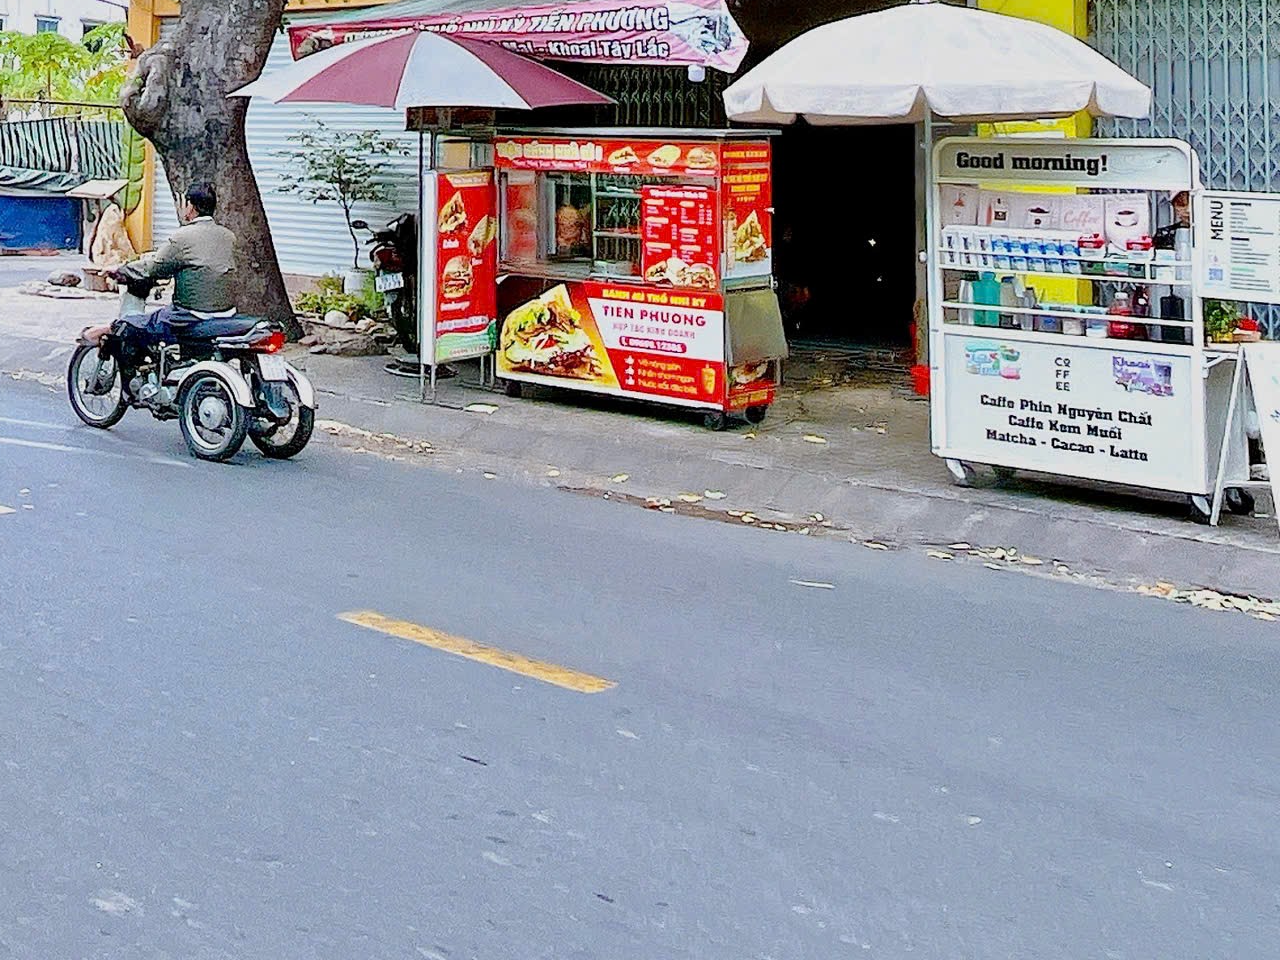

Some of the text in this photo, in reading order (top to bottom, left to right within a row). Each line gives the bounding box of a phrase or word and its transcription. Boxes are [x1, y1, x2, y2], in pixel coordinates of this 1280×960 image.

[547, 41, 597, 58] Khoai
[599, 39, 632, 59] Tây
[956, 152, 1108, 176] Good morning!
[1210, 200, 1224, 241] MENU
[1055, 370, 1070, 380] FF
[1056, 381, 1070, 391] EE
[1019, 398, 1053, 414] Phin
[1048, 419, 1081, 435] Kem
[985, 427, 1037, 447] Matcha
[1051, 437, 1095, 455] Cacao
